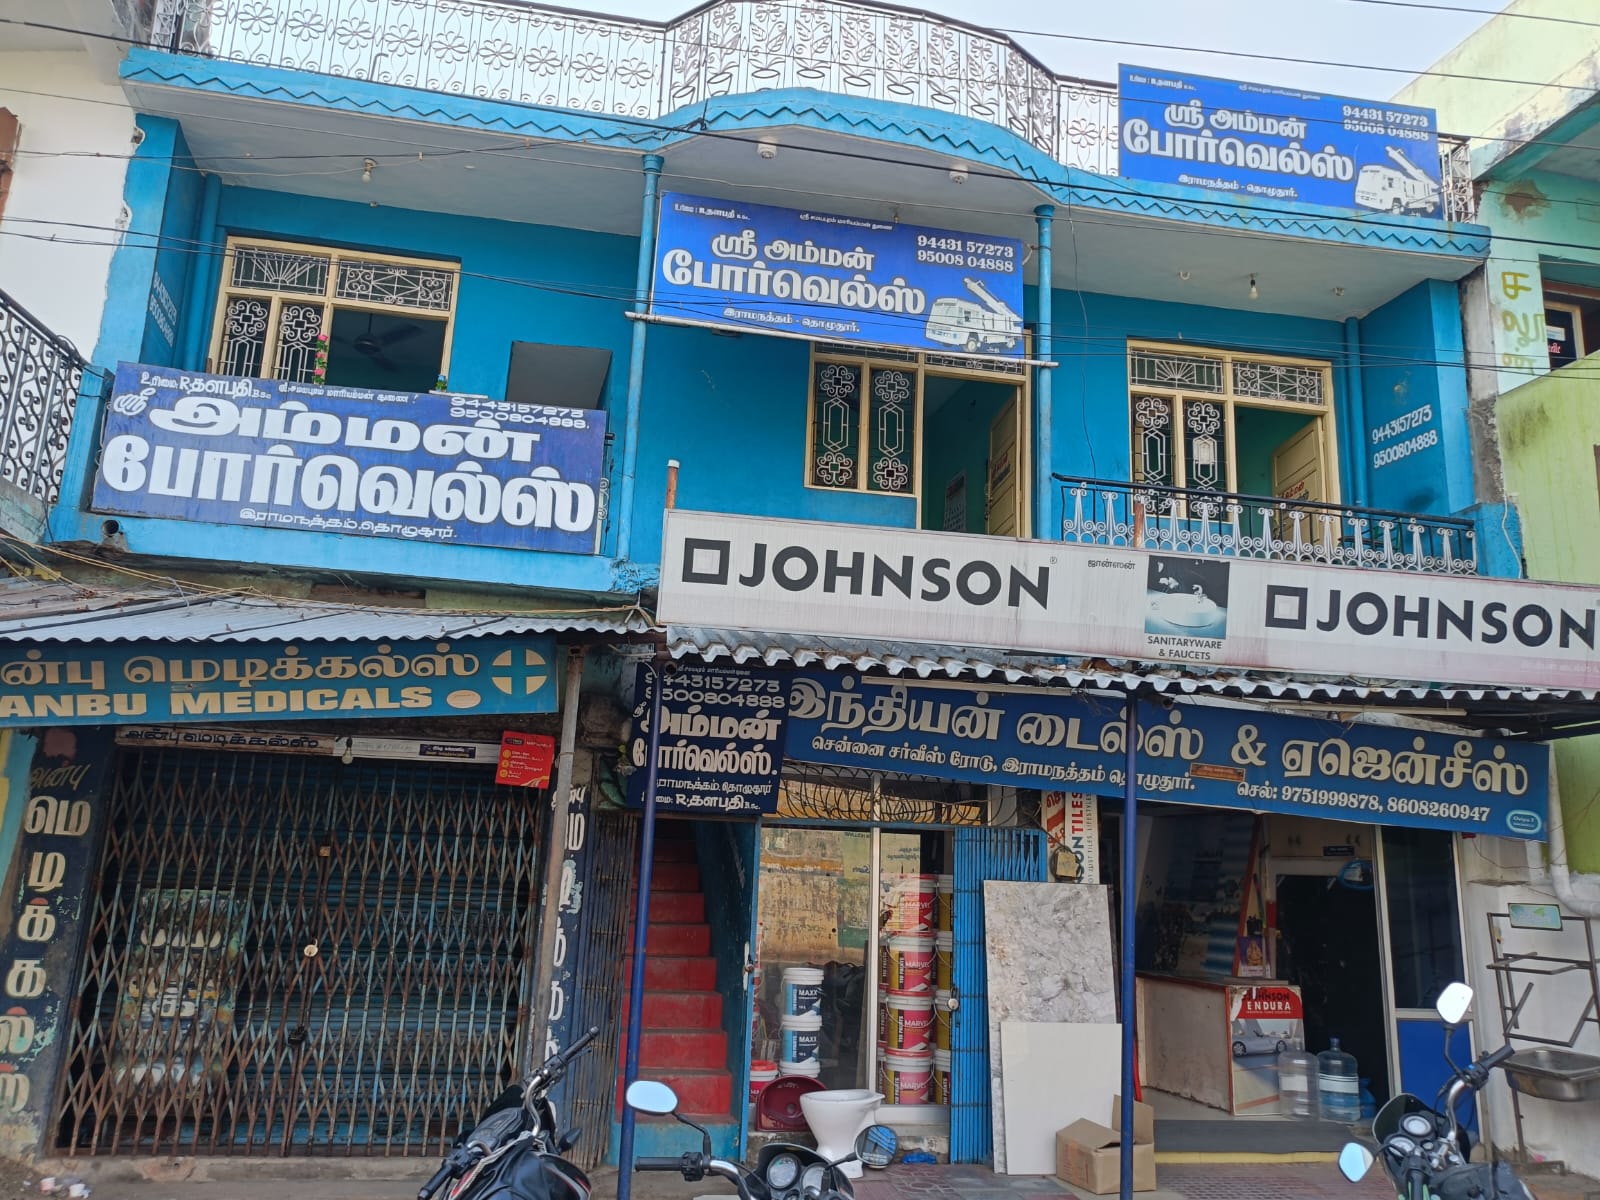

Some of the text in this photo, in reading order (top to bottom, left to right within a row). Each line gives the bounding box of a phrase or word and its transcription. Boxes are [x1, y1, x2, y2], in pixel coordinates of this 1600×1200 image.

[1209, 107, 1307, 139] அம்மன்
[1342, 105, 1429, 128] 94431 57273
[1123, 118, 1354, 182] போர்வெல்ஸ்
[764, 239, 874, 272] அம்மன்
[917, 234, 1014, 259] 94431 57273
[917, 249, 1014, 274] 95008 04888
[662, 248, 925, 315] போர்வெல்ஸ்
[450, 396, 584, 419] 9443157273
[1372, 404, 1433, 445] 9443157273
[149, 395, 541, 463] அம்மன்
[1373, 429, 1438, 469] 9500804888
[101, 433, 596, 533] போர்வெல்ஸ்
[738, 542, 1050, 610] JOHNSON
[1315, 588, 1596, 651] JOHNSON
[1147, 635, 1223, 649] SANITARYWARE
[1158, 648, 1211, 661] & FAUCETS
[123, 643, 480, 689] மெடிக்கல்ஸ்
[0, 686, 434, 719] ANBU MEDICALS
[788, 675, 1528, 797] இந்தியன் டைல்ஸ் & ஏஜென்சீஸ்
[811, 735, 885, 758] சென்னை
[888, 742, 946, 765] சர்வீஸ்
[950, 749, 998, 773] ரோடு,
[1002, 757, 1106, 784] இராமநத்தம்
[1237, 780, 1277, 800] செல்:
[1281, 786, 1384, 814] 9751999878,
[1387, 796, 1491, 823] 8608260947
[1246, 1001, 1291, 1010] ENDURA
